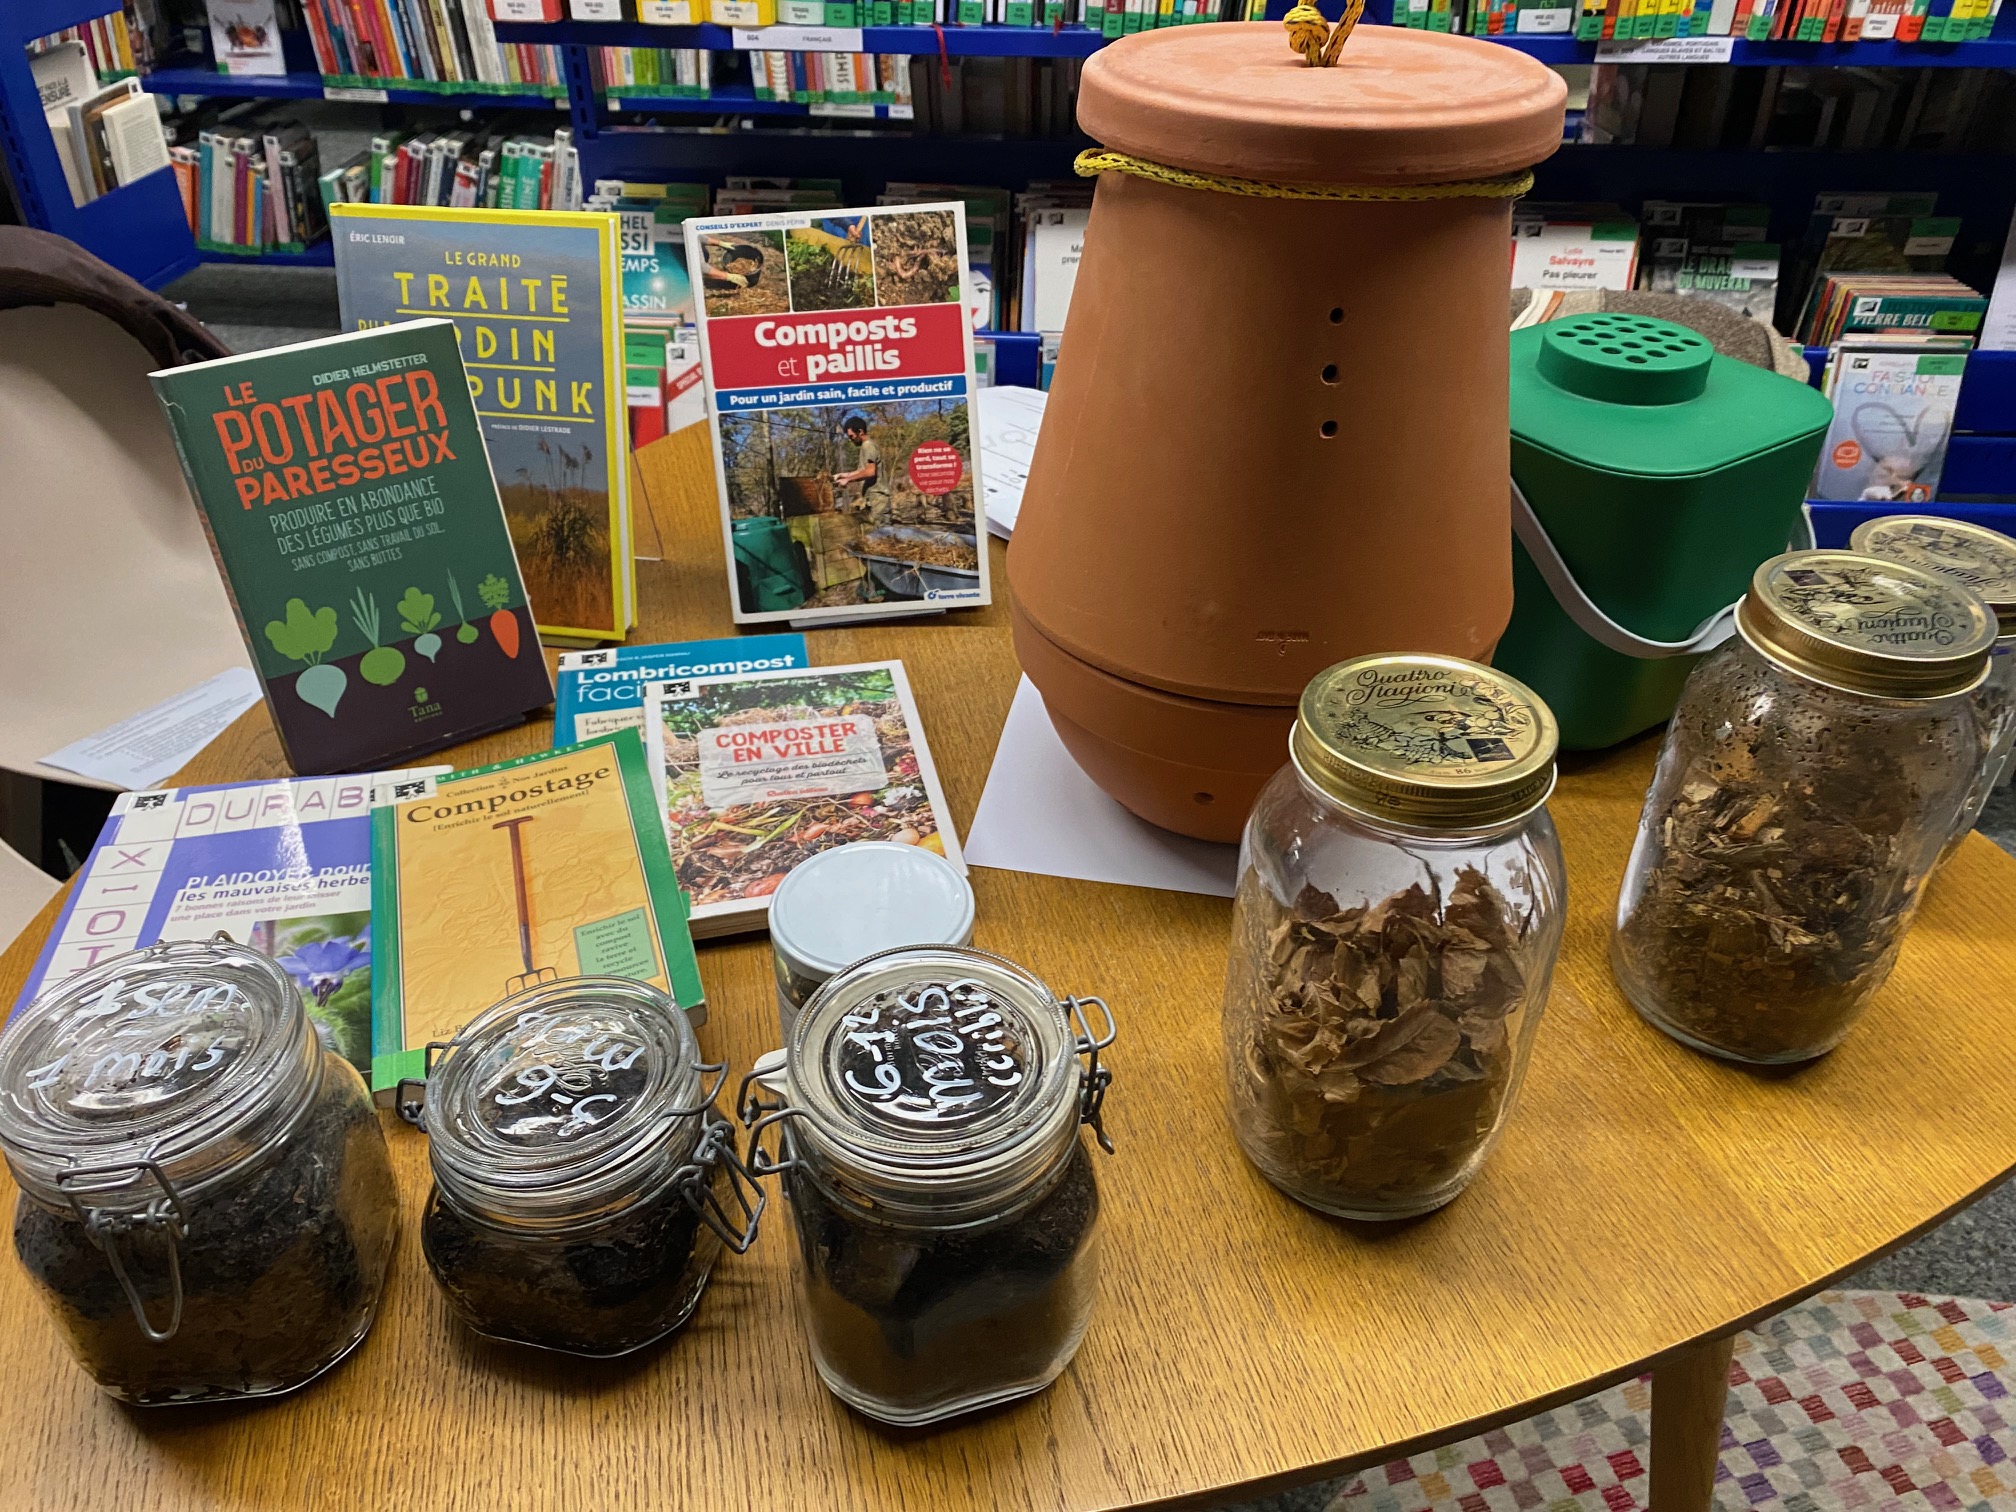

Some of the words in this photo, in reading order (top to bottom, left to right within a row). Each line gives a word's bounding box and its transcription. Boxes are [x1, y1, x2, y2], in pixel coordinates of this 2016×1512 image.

[695, 222, 728, 231] CONSEILS
[729, 220, 762, 230] D'EXPERT
[350, 231, 370, 243] ÉRIC
[372, 233, 405, 245] LENOIR
[445, 251, 462, 265] LE
[466, 253, 522, 268] GRAND
[1549, 255, 1595, 268] Salvayre
[1542, 269, 1561, 279] Pas
[1562, 270, 1597, 281] pleurer
[393, 271, 569, 314] TRAITÉ
[754, 315, 917, 350] Composts
[312, 368, 350, 386] DIDIER
[352, 353, 428, 378] HELMSTETTER
[777, 358, 799, 377] et
[806, 343, 901, 382] paillis
[223, 381, 257, 407] LE
[730, 393, 760, 406] Pour
[761, 392, 777, 403] un
[777, 389, 815, 405] jardin
[817, 387, 846, 400] sain,
[847, 384, 880, 399] facile
[881, 385, 895, 397] et
[897, 380, 953, 398] productif
[211, 369, 448, 476] POTAGER
[540, 426, 571, 434] LESTRADE
[235, 429, 457, 511] PARESSEUX
[241, 456, 264, 473] DU
[916, 462, 953, 470] transforme
[928, 478, 943, 486] pour
[269, 498, 336, 533] PRODUIRE
[340, 496, 358, 517] EN
[360, 475, 439, 513] ABONDANCE
[277, 532, 304, 555] DES
[305, 516, 364, 548] LÉGUMES
[364, 509, 396, 533] PLUS
[397, 500, 424, 526] QUE
[425, 497, 445, 518] BIO
[291, 553, 315, 571] SANS
[357, 538, 380, 556] SANS
[379, 529, 412, 551] TRAVAIL
[412, 526, 426, 541] DU
[347, 555, 371, 572] SANS
[371, 547, 403, 568] BUTTES
[955, 591, 980, 599] vivante
[577, 653, 795, 684] Lombricompost
[1356, 669, 1452, 687] Quattro
[1346, 681, 1474, 709] Stagioni
[408, 700, 442, 718] Tana
[716, 722, 858, 749] COMPOSTER
[733, 747, 762, 763] EN
[773, 738, 846, 760] VILLE
[716, 769, 734, 779] Le
[736, 764, 787, 778] recyclage
[792, 763, 809, 771] des
[811, 756, 868, 770] biodéchets
[740, 776, 767, 786] pour
[768, 773, 792, 781] tous
[795, 771, 805, 779] et
[806, 767, 848, 780] partout
[1455, 765, 1472, 776] 86
[446, 783, 494, 798] Collection
[512, 775, 530, 783] Nos
[532, 765, 568, 779] Jardins
[406, 766, 611, 824] Compostage
[482, 814, 493, 822] le
[495, 809, 511, 819] sol
[187, 864, 315, 889] PLAIDOYER
[180, 889, 207, 903] les
[213, 878, 310, 899] mauvaises
[170, 914, 191, 922] une
[193, 910, 224, 923] place
[226, 907, 252, 918] dans
[254, 905, 282, 915] votre
[283, 900, 317, 915] jardin
[175, 904, 182, 912] 7
[184, 901, 225, 912] bonnes
[226, 898, 264, 909] raisons
[265, 895, 281, 905] de
[283, 893, 304, 903] leur
[581, 922, 616, 936] Enrichir
[627, 914, 640, 922] sol
[595, 931, 615, 940] avec
[595, 933, 631, 948] compost
[601, 942, 629, 953] ravive
[602, 956, 633, 969] recycle
[606, 950, 627, 960] terre
[432, 1026, 452, 1038] Liz
[898, 987, 984, 1109] mois
[84, 1034, 228, 1088] mois
